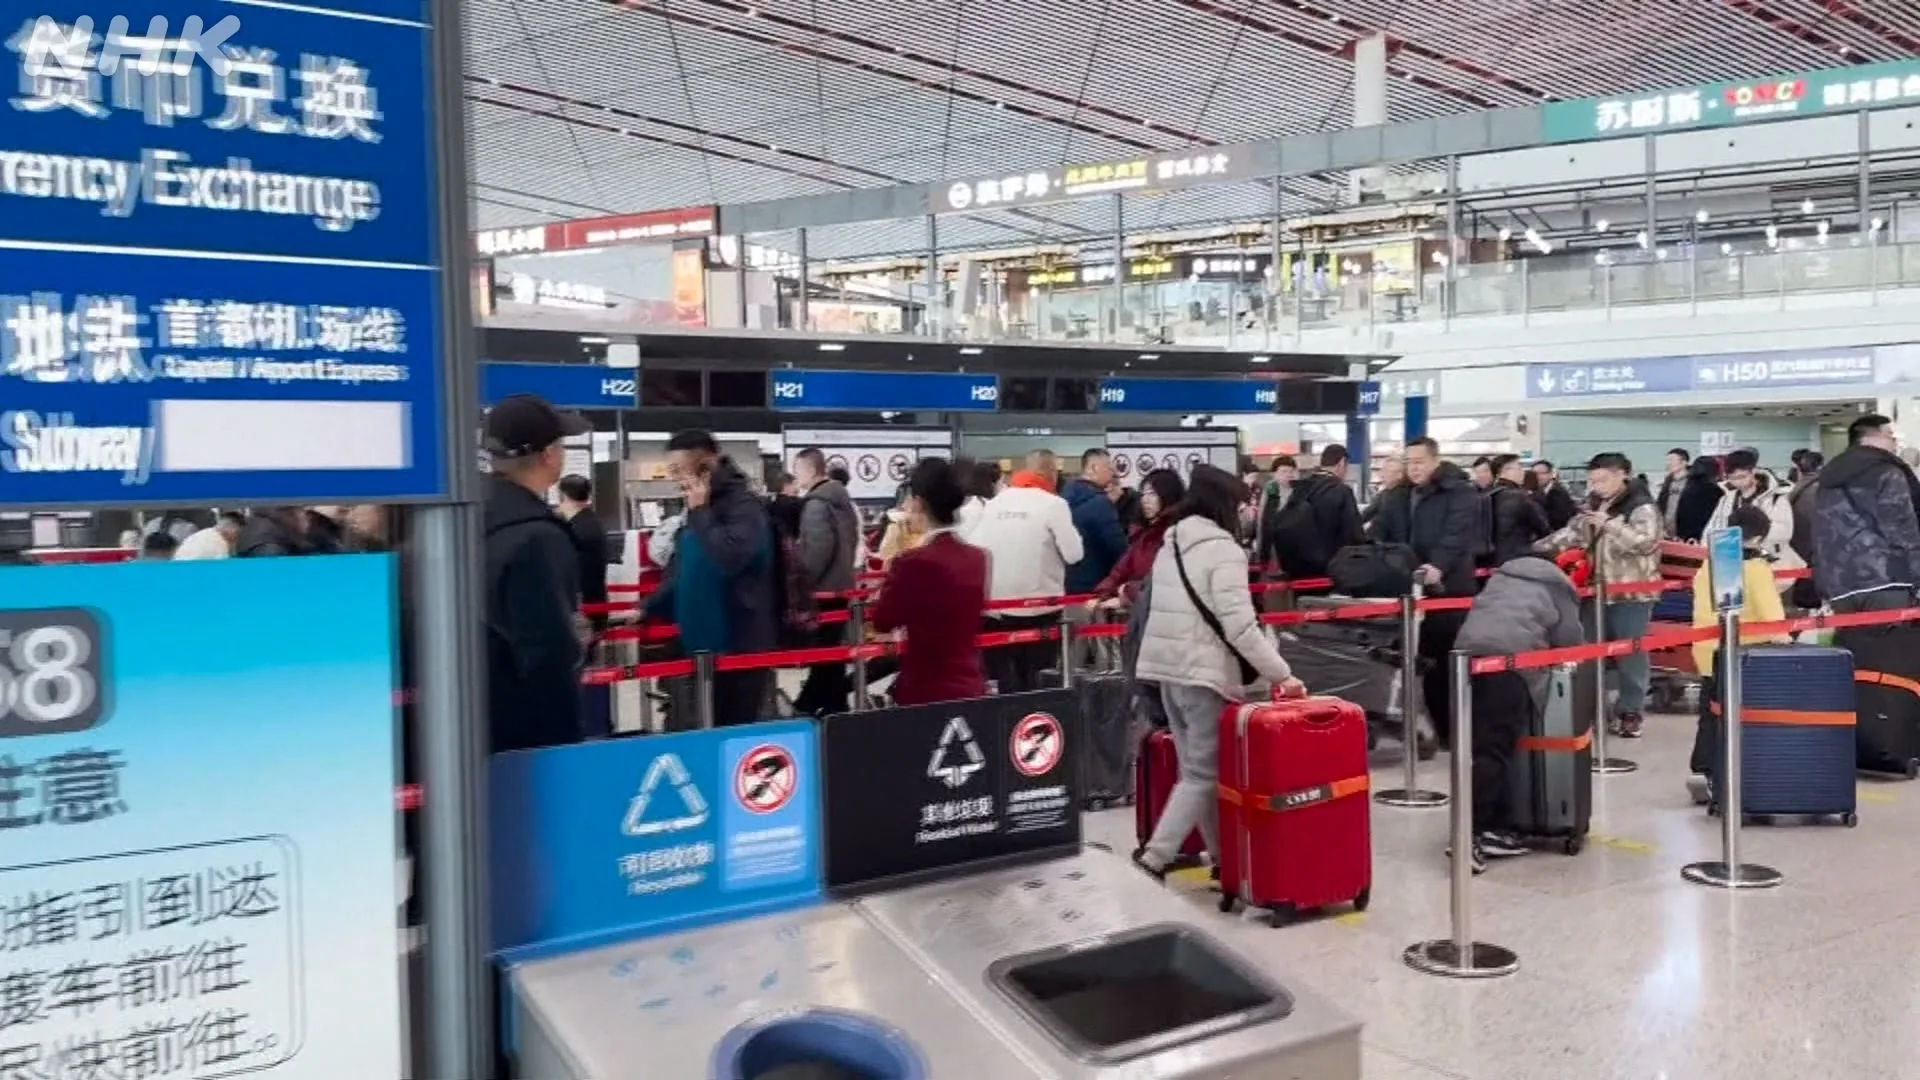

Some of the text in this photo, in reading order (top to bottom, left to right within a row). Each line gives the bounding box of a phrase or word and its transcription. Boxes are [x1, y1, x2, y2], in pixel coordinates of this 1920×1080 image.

[5, 18, 384, 144] 货币兑换
[140, 148, 382, 233] Exchange
[0, 291, 407, 383] 地铁 首都机场线
[1723, 363, 1768, 383] H50
[601, 379, 635, 396] H22
[775, 382, 804, 398] H21
[971, 385, 998, 401] H20
[1101, 388, 1126, 402] H19
[1255, 389, 1277, 404] H18
[1359, 391, 1379, 404] H17
[0, 409, 155, 485] Subway
